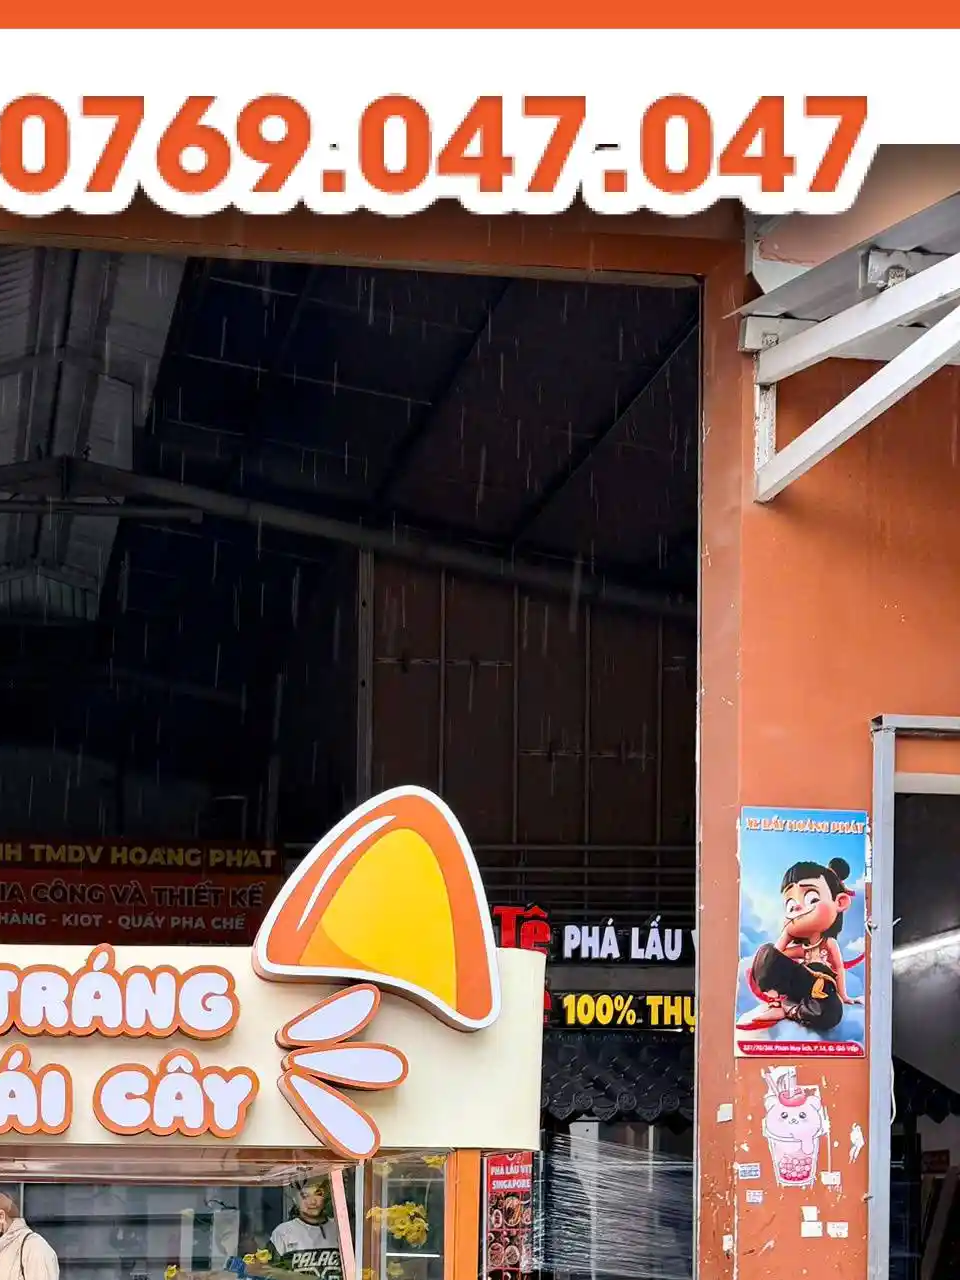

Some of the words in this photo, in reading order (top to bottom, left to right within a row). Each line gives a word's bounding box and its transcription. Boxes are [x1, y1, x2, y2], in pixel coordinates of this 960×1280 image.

[30, 844, 104, 864] TMDV
[31, 877, 105, 905] CÔNG
[111, 879, 147, 905] VÀ
[153, 879, 225, 908] THIẾT
[62, 912, 104, 928] KIOT
[170, 915, 206, 930] PHA
[563, 917, 621, 960] PHÁ
[631, 914, 683, 960] LẤU
[563, 993, 637, 1026] 100%
[96, 1050, 257, 1135] CÂY
